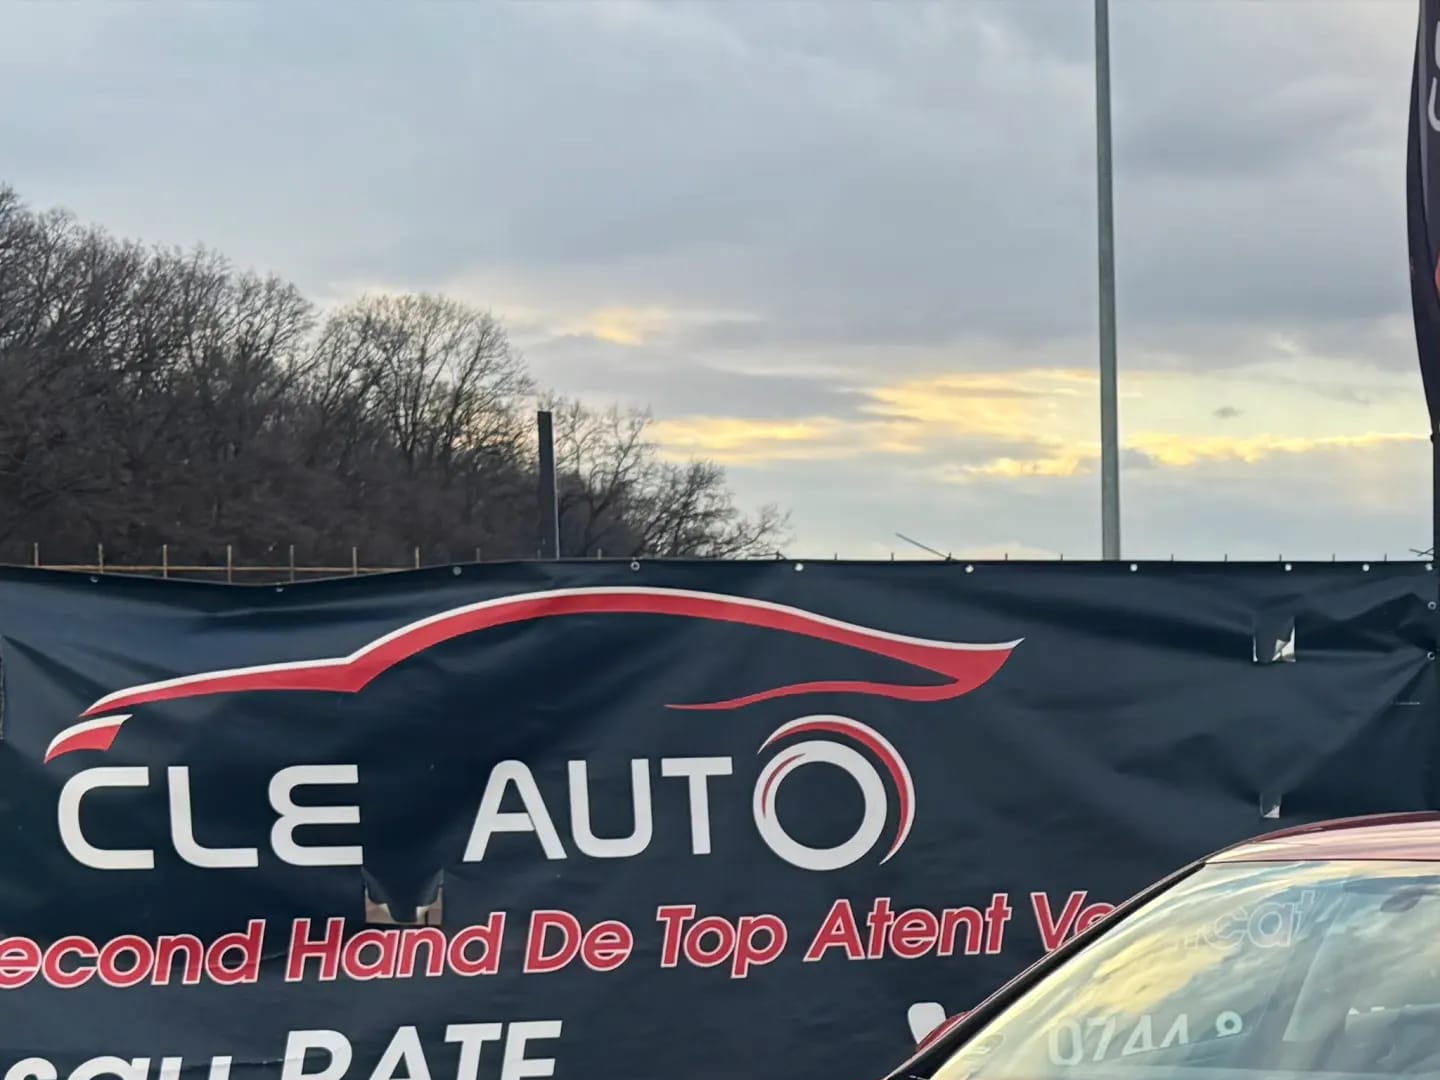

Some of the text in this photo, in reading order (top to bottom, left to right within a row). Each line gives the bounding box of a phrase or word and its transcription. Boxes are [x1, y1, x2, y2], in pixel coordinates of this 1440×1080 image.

[57, 740, 889, 872] CLE AUTO
[284, 911, 506, 982] Hand
[523, 909, 633, 973] De
[656, 904, 787, 979] Top
[803, 892, 1011, 962] Atent
